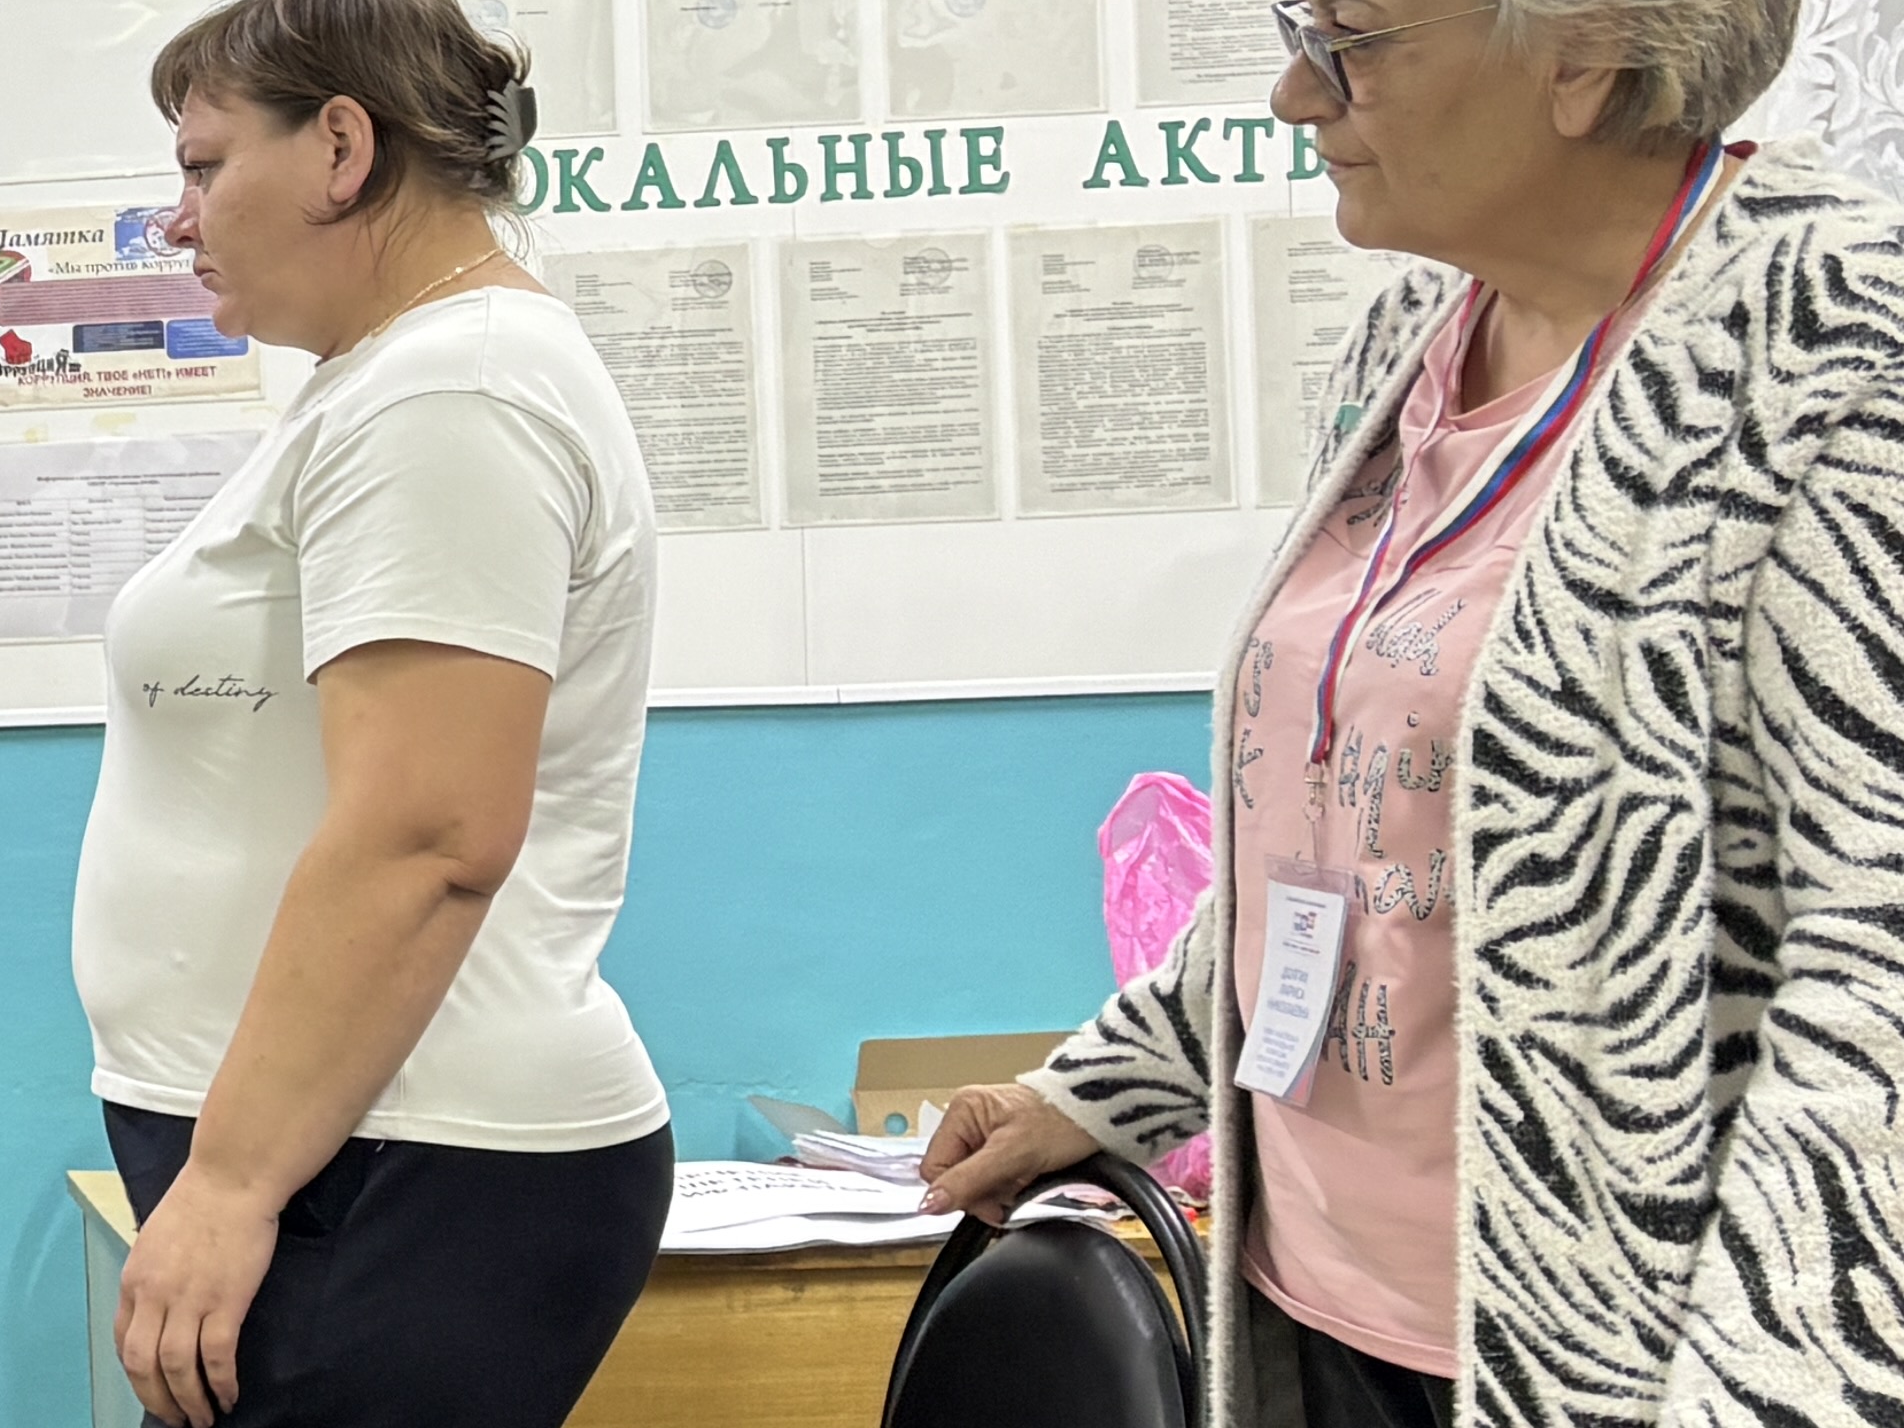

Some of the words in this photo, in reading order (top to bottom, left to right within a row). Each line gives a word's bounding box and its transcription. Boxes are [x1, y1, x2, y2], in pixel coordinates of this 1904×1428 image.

[516, 125, 1012, 215] ОКАЛЬНЫЕ
[142, 682, 164, 708] of
[173, 674, 280, 712] destiny
